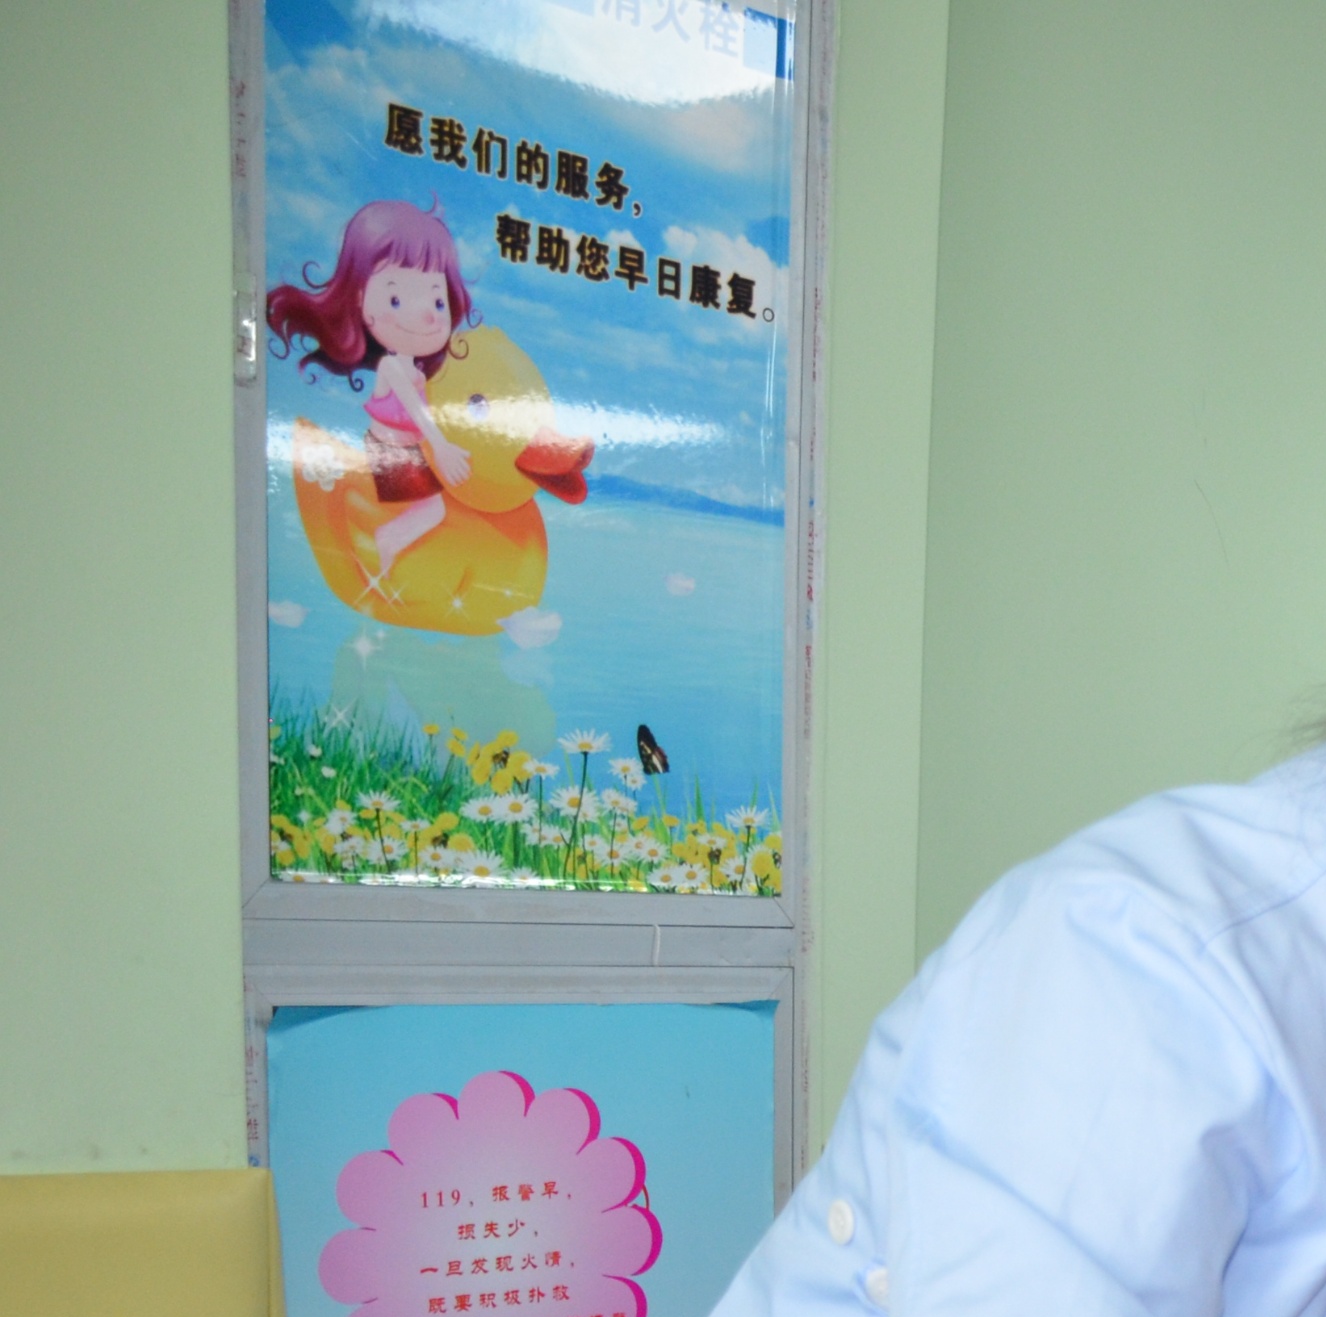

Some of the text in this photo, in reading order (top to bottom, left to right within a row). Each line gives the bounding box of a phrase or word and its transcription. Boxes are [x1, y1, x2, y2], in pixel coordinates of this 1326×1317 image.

[383, 102, 642, 218] 愿我们的服务，
[495, 213, 776, 323] 帮助您早日康复。
[457, 1219, 538, 1240] 损失少，
[420, 1251, 575, 1277] 一旦发现火情，
[428, 1285, 570, 1314] 既要积极扑救
